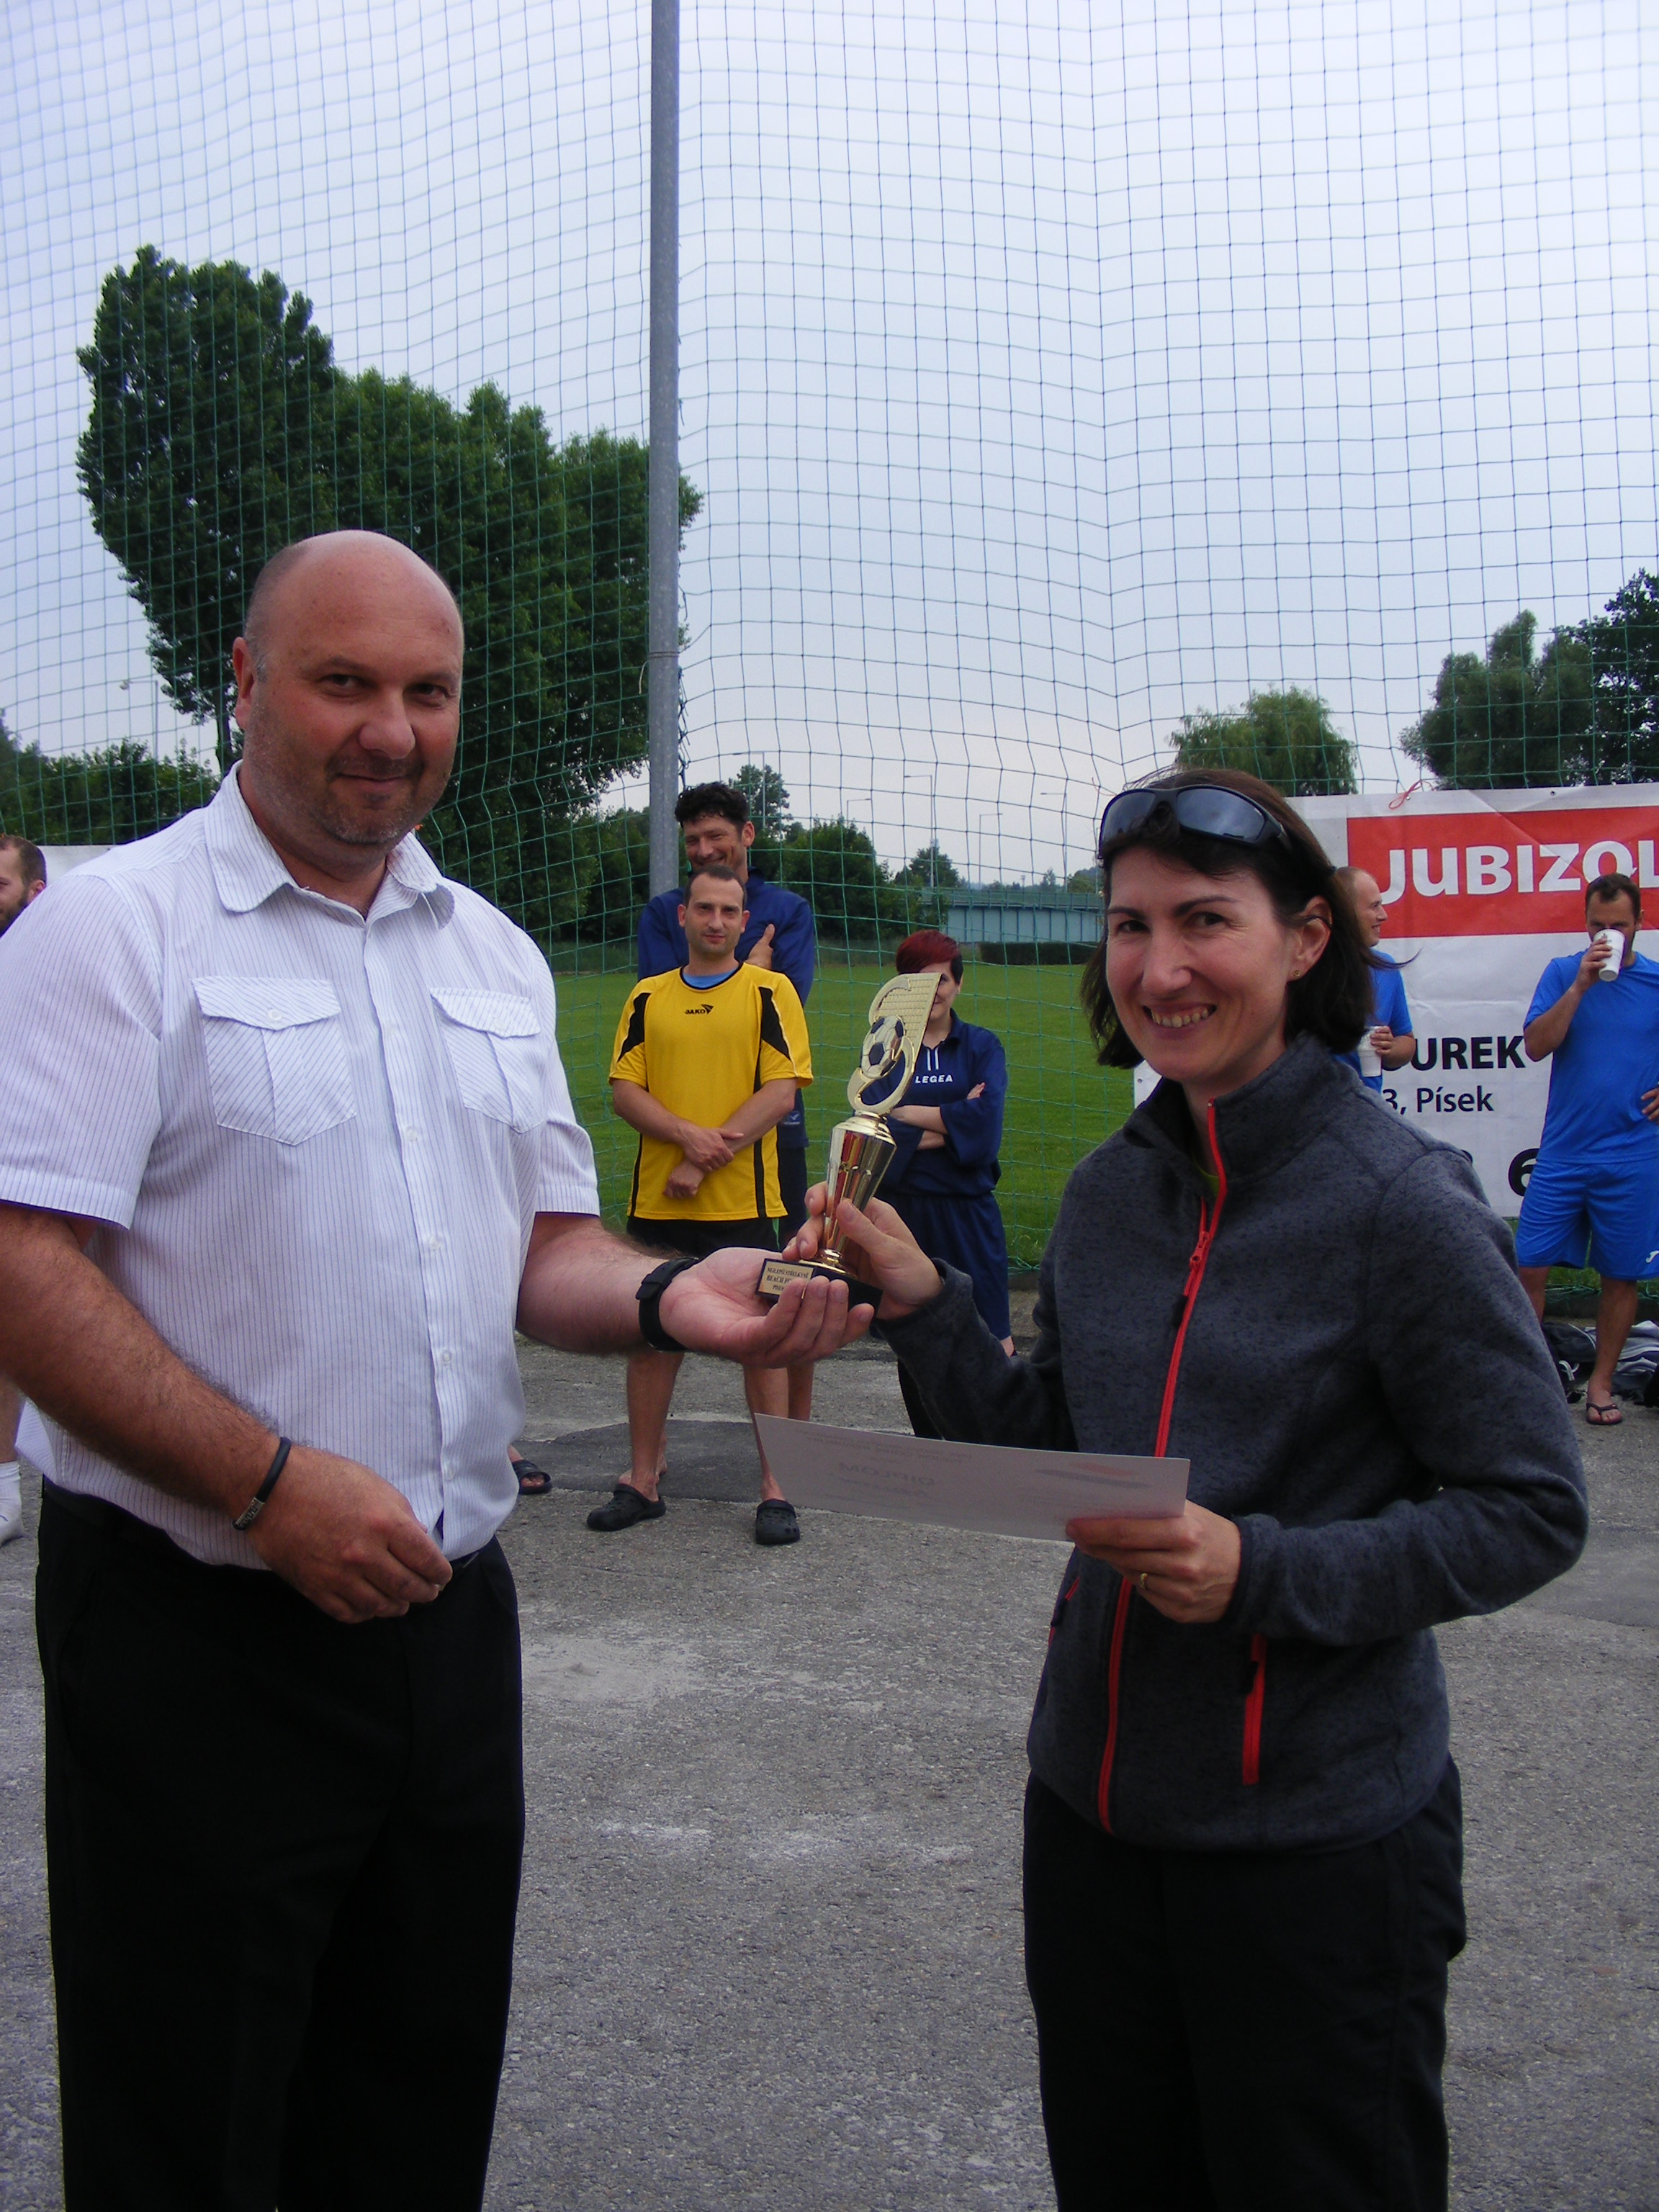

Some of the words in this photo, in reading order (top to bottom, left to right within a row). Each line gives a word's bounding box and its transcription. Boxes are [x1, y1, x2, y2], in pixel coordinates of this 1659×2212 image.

[1380, 840, 1659, 905] JUBIZOL
[914, 1074, 953, 1084] LEGEA
[1417, 1085, 1494, 1112] Písek
